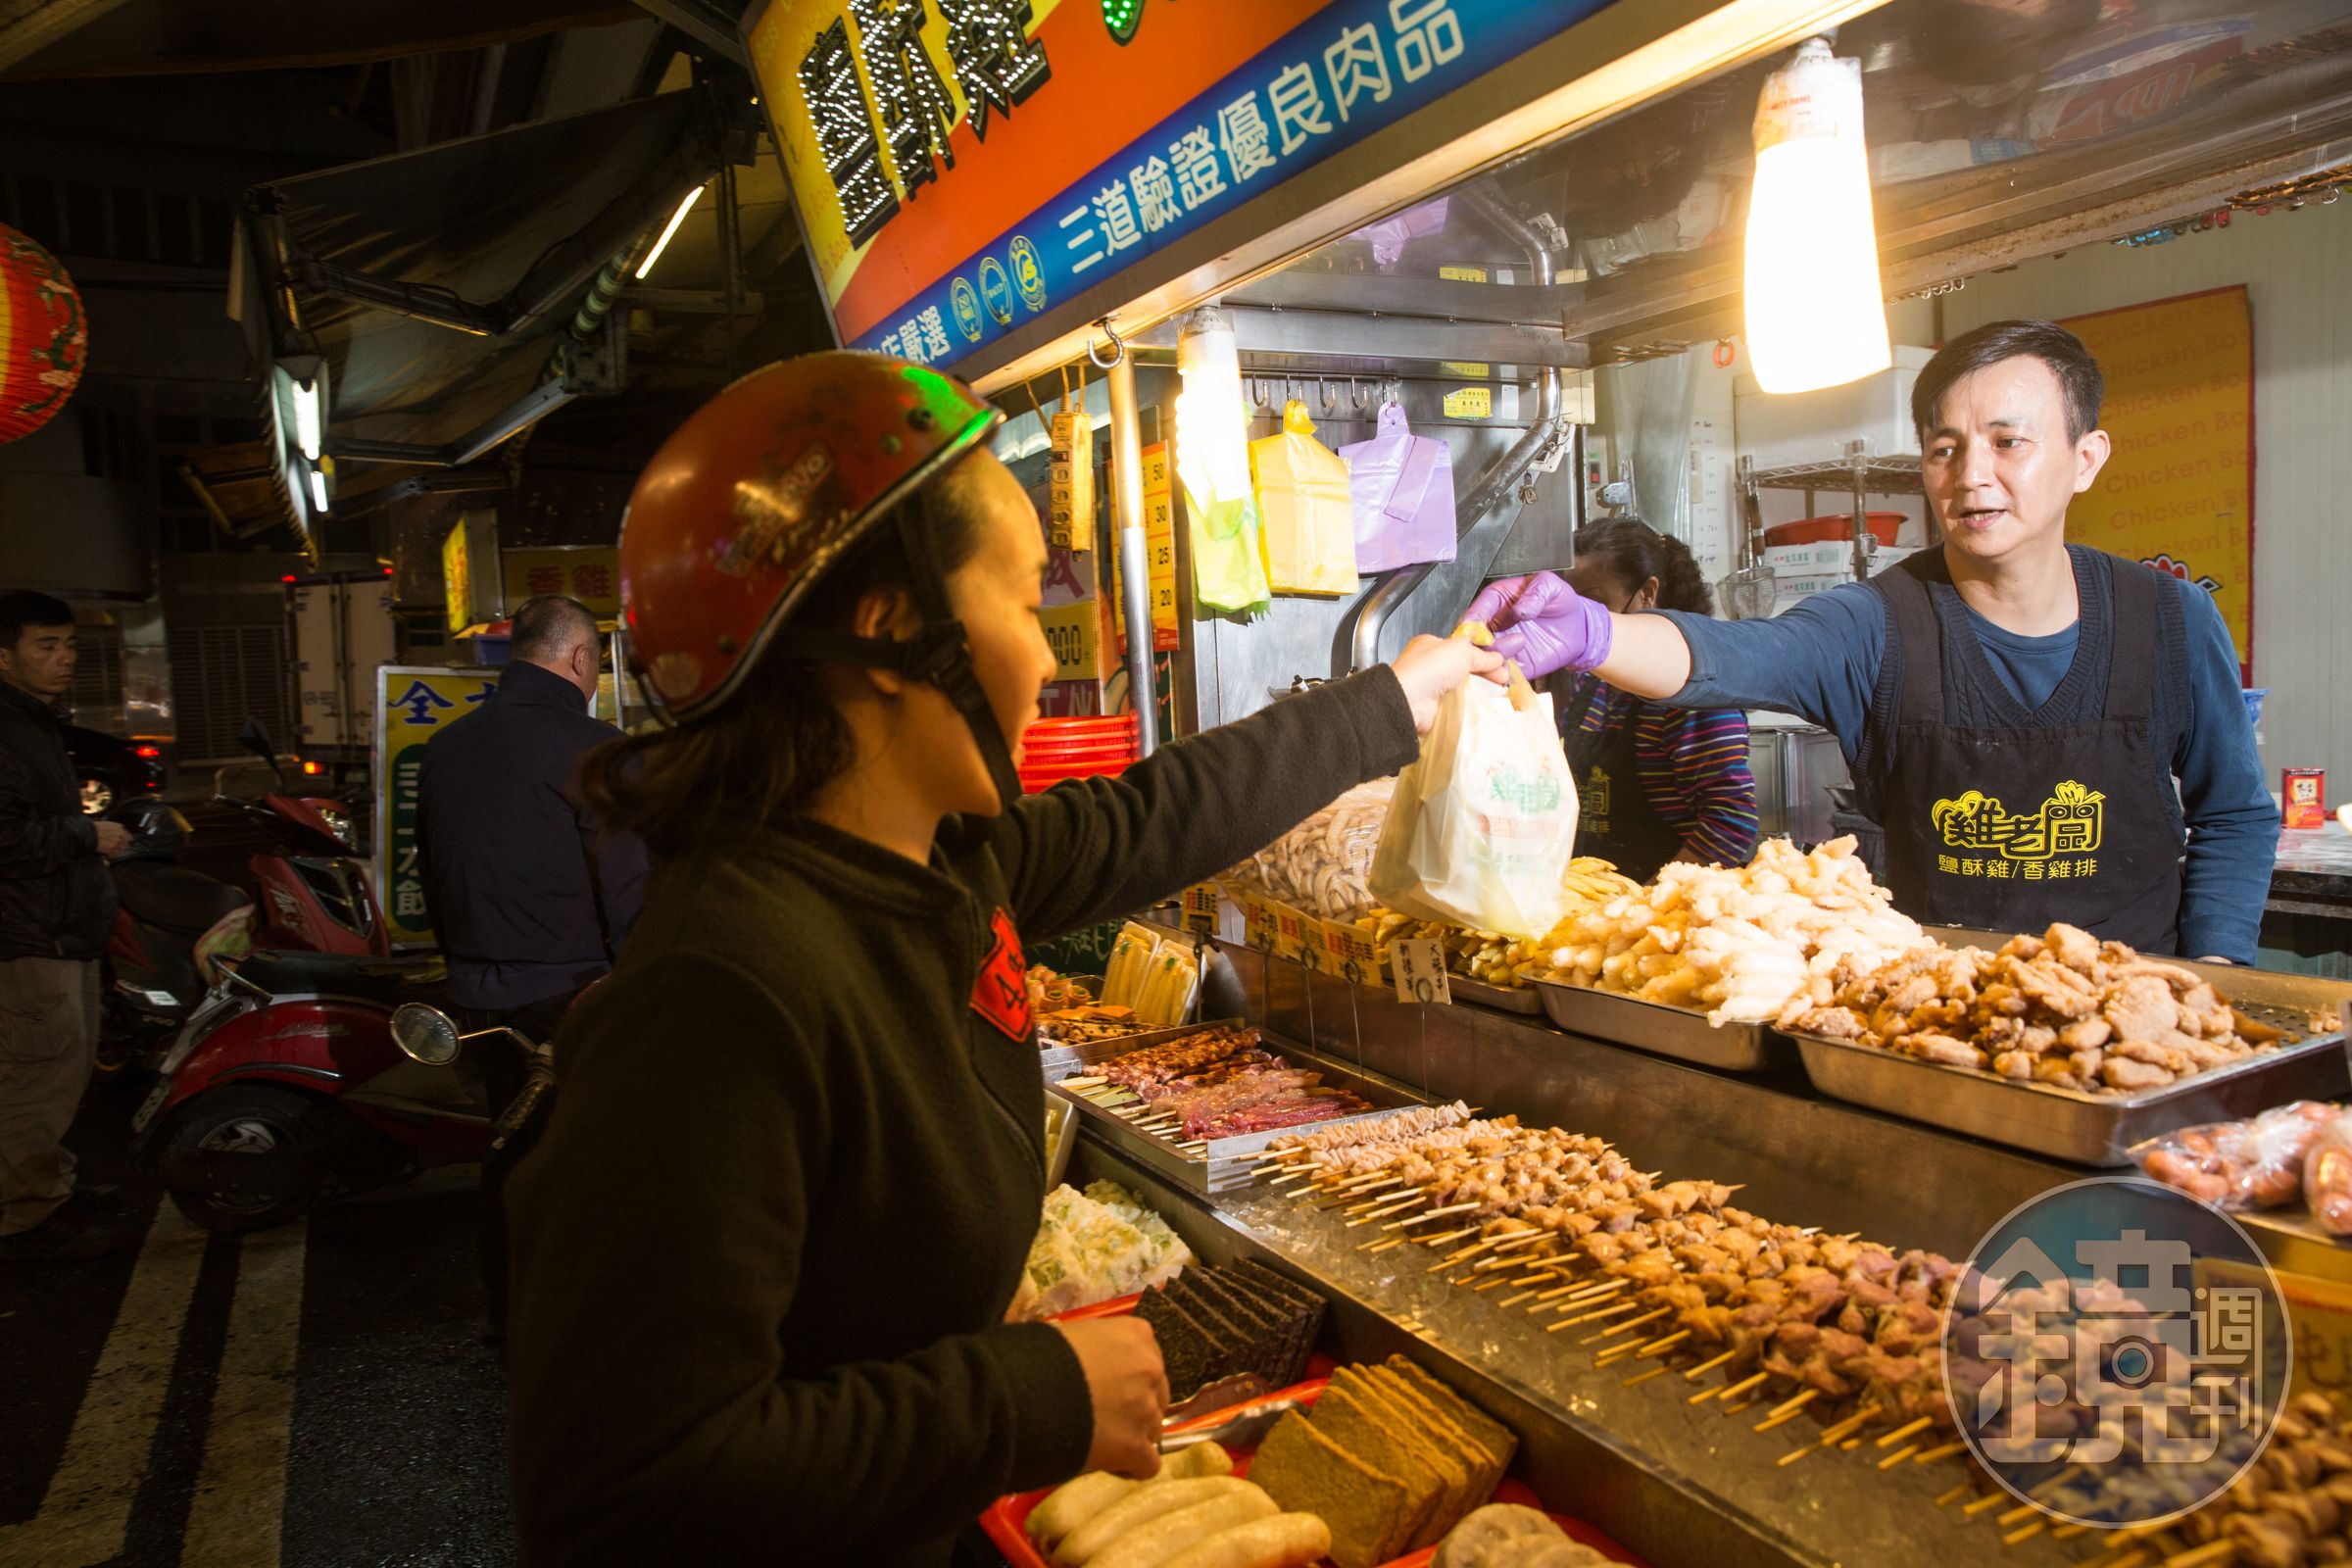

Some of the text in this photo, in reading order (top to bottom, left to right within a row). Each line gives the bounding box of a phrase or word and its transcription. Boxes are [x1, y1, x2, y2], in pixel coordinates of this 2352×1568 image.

[1059, 0, 1465, 273] 三道驗證優良肉品
[2105, 457, 2211, 493] Chicken
[2110, 495, 2215, 530] Chicken
[1932, 780, 2106, 859] 雞老闆
[1938, 855, 2097, 880] 鹽酥雞/香雞排
